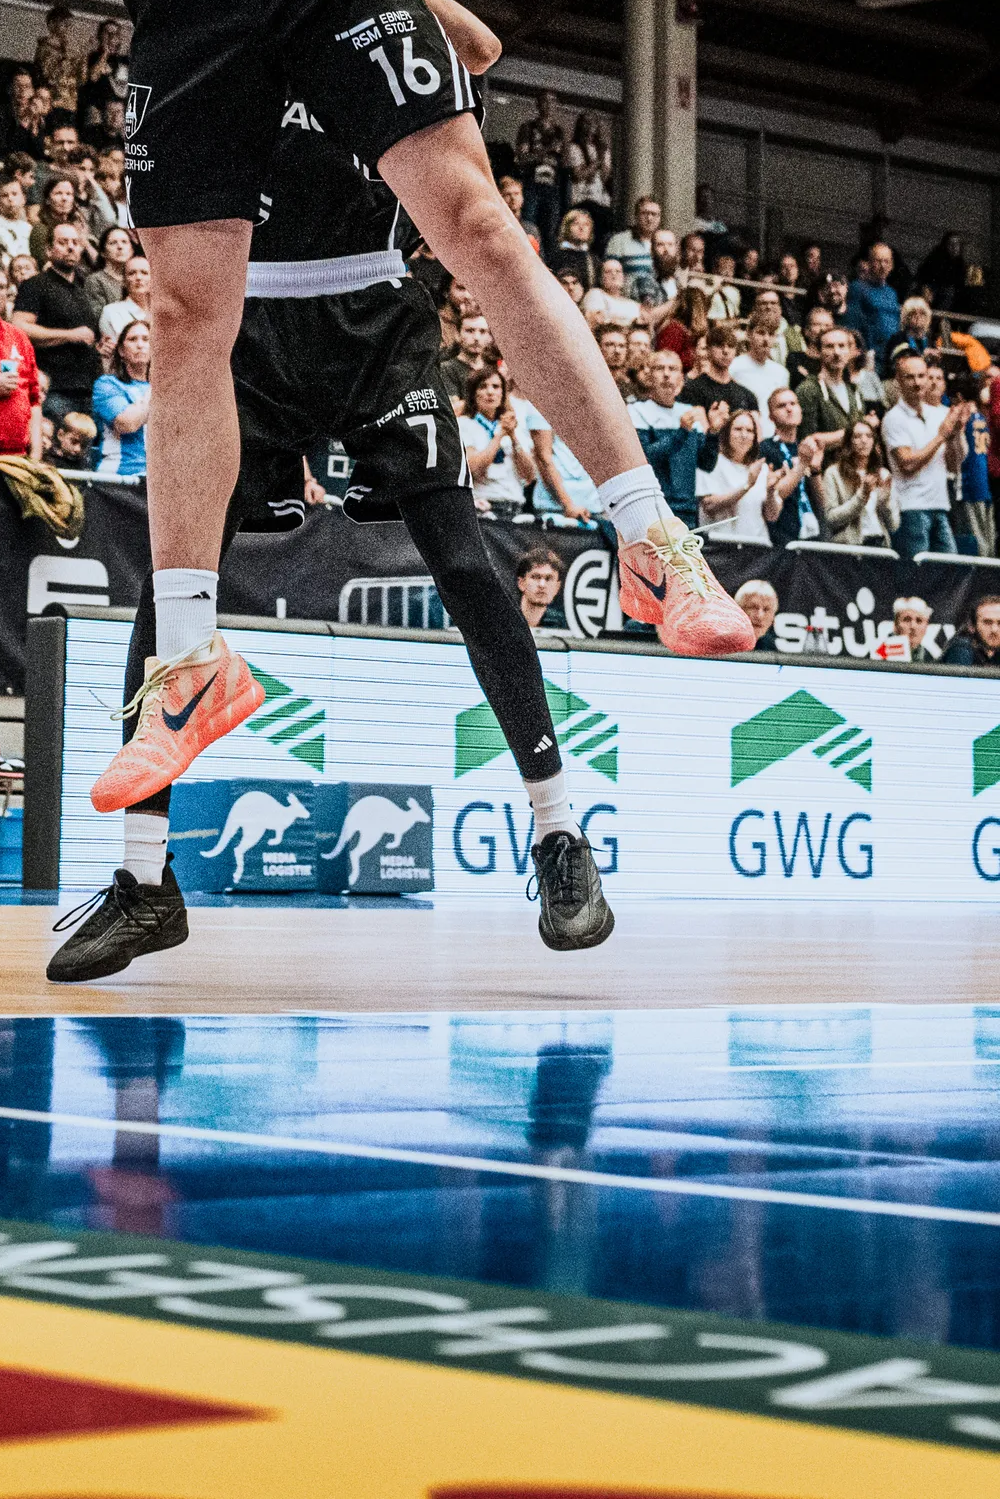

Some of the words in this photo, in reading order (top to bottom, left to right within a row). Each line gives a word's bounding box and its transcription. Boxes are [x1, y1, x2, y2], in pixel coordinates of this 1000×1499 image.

[379, 10, 412, 25] EBNER
[352, 26, 383, 50] RSM
[384, 20, 417, 35] STOLZ
[368, 36, 441, 107] 16
[405, 388, 436, 402] EBNER
[407, 399, 439, 412] STOLZ
[405, 414, 438, 469] 7
[729, 809, 874, 879] GWG
